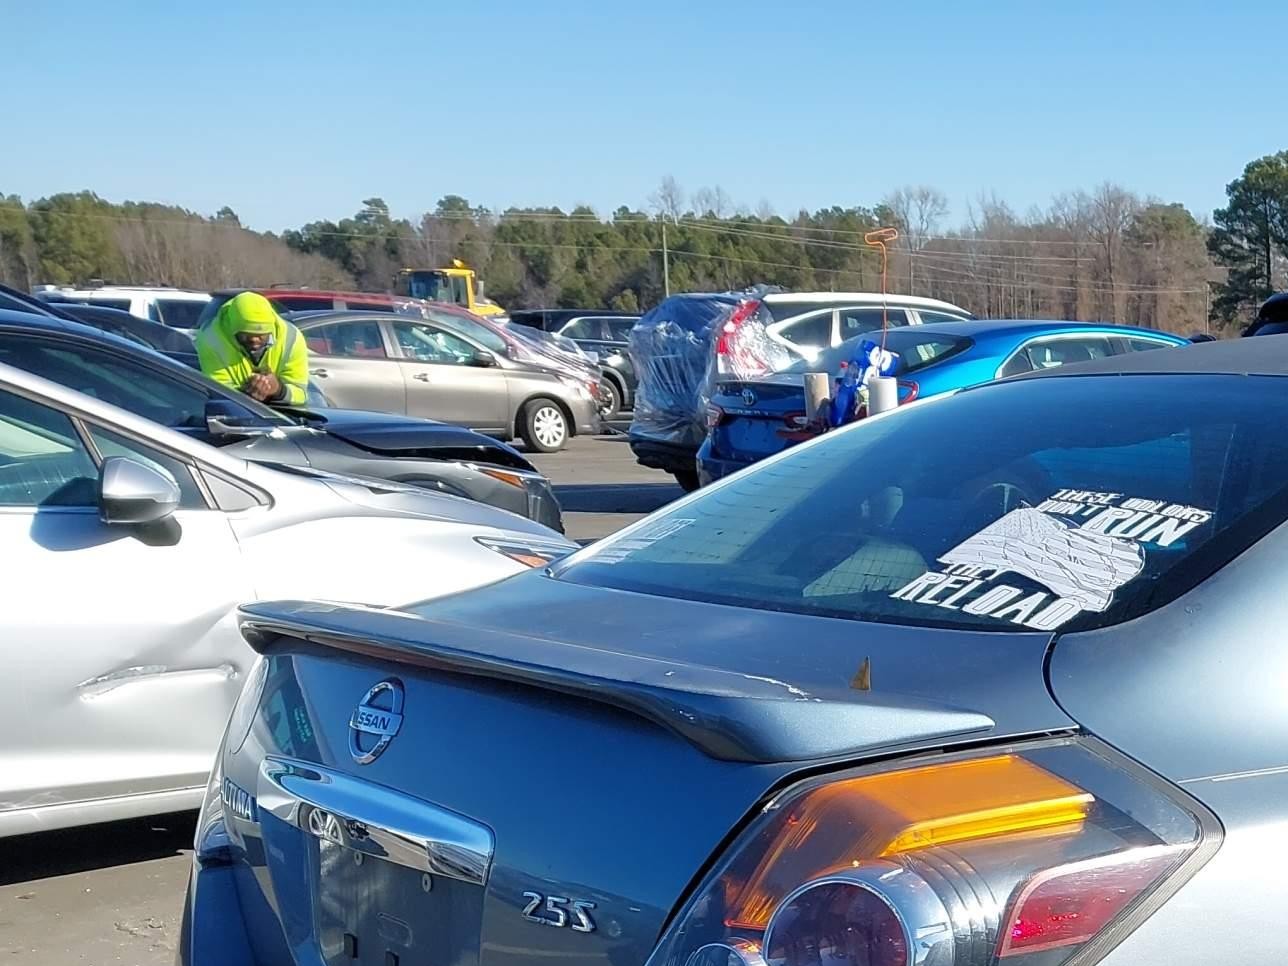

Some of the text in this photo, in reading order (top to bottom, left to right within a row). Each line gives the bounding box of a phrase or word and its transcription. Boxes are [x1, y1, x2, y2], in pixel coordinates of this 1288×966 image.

[1051, 490, 1215, 523] THESE COLORS
[1080, 505, 1200, 547] RUN
[889, 571, 1083, 632] RELOAD
